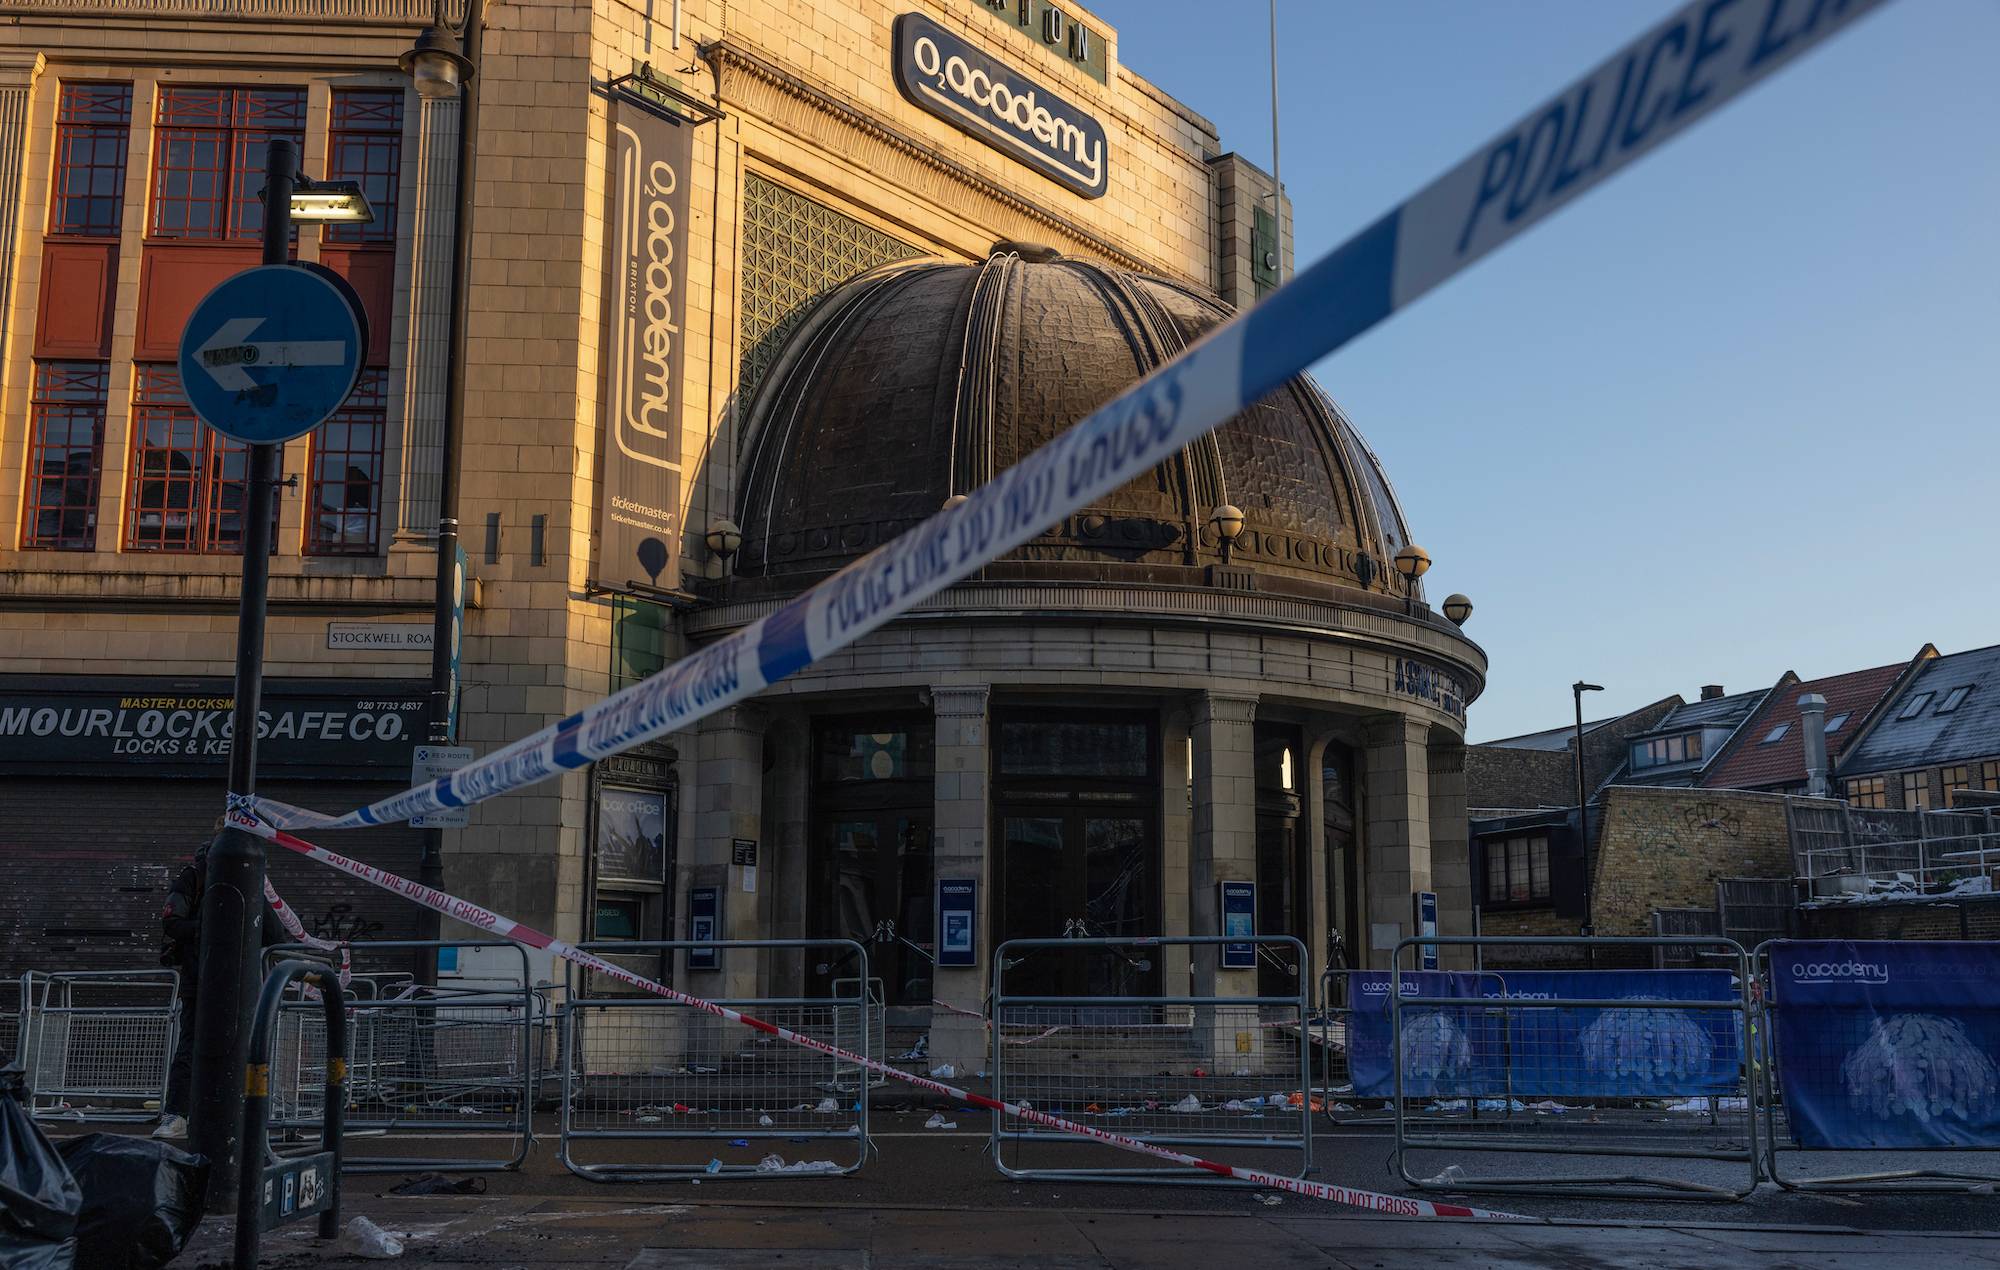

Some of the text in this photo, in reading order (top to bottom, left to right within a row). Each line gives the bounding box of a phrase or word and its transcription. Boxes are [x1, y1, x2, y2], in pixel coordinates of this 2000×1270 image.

[1457, 0, 1732, 255] POLICE
[629, 260, 638, 314] BRIXTON
[611, 496, 672, 521] ticketmaster
[611, 512, 672, 535] ticketmaster.co.uk
[332, 632, 433, 644] STOCKWELL ROA
[120, 698, 235, 710] MASTER LOCKSM
[357, 701, 423, 711] 020 7733 4537
[113, 739, 232, 755] LOCKS & KE
[602, 798, 660, 816] box office
[596, 907, 620, 917] OSED
[1327, 1187, 1344, 1205] DO
[1348, 1191, 1374, 1209] NOT
[1376, 1196, 1419, 1217] CROSS
